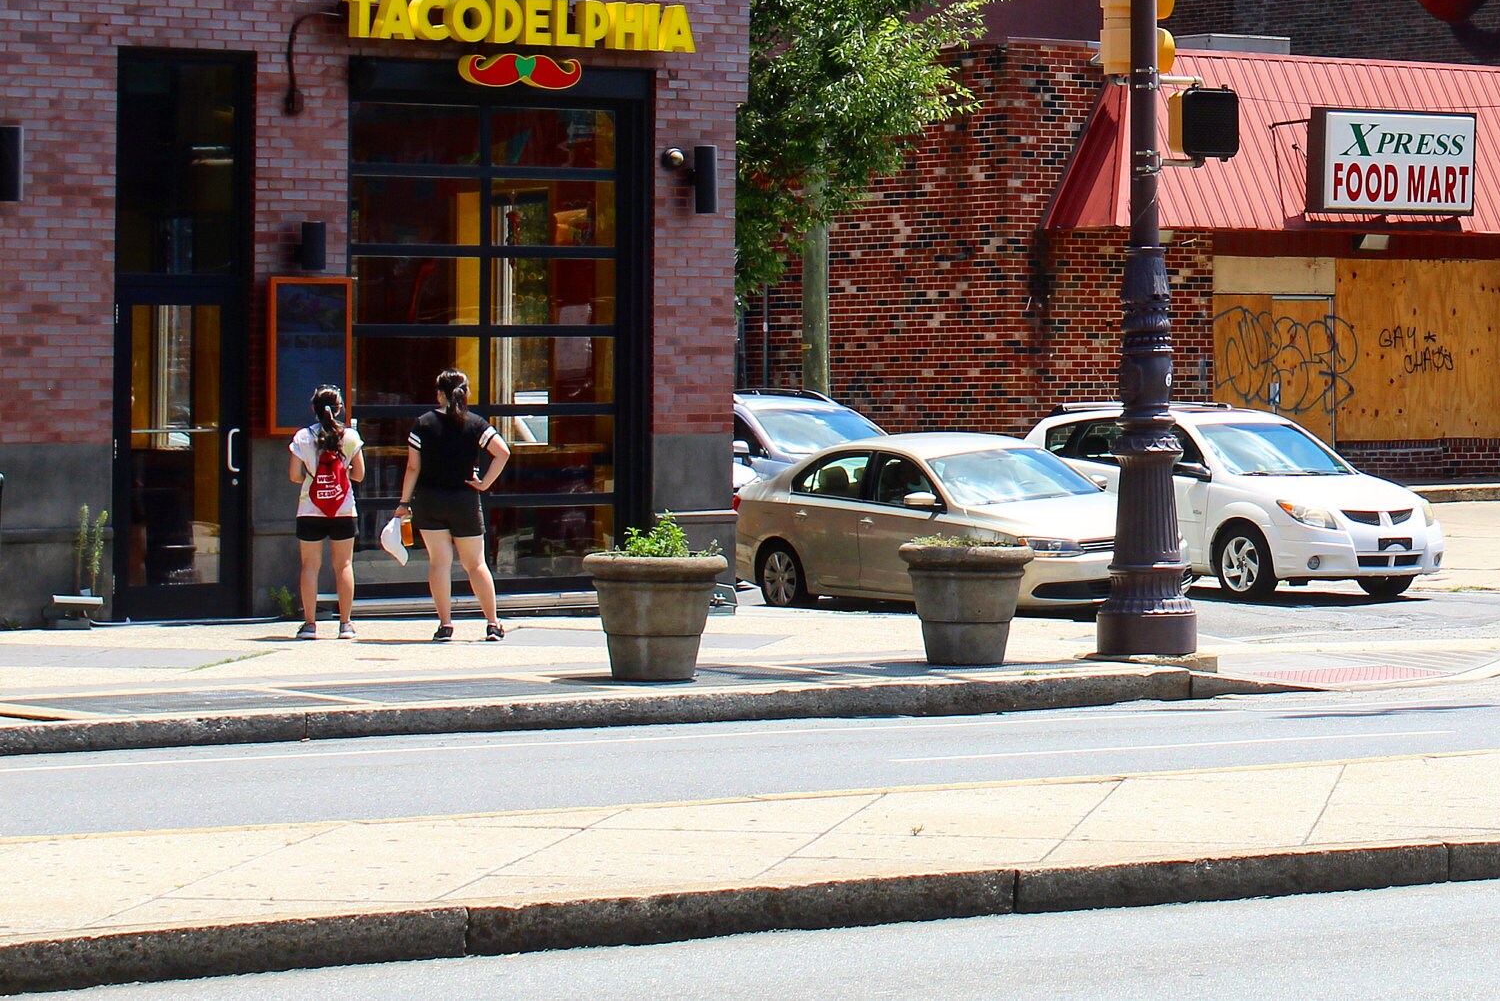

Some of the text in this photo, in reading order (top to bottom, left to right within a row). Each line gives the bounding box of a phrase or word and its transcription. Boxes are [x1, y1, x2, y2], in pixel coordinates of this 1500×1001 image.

[1339, 122, 1466, 157] XPRESS
[1333, 162, 1470, 204] FOOD MART
